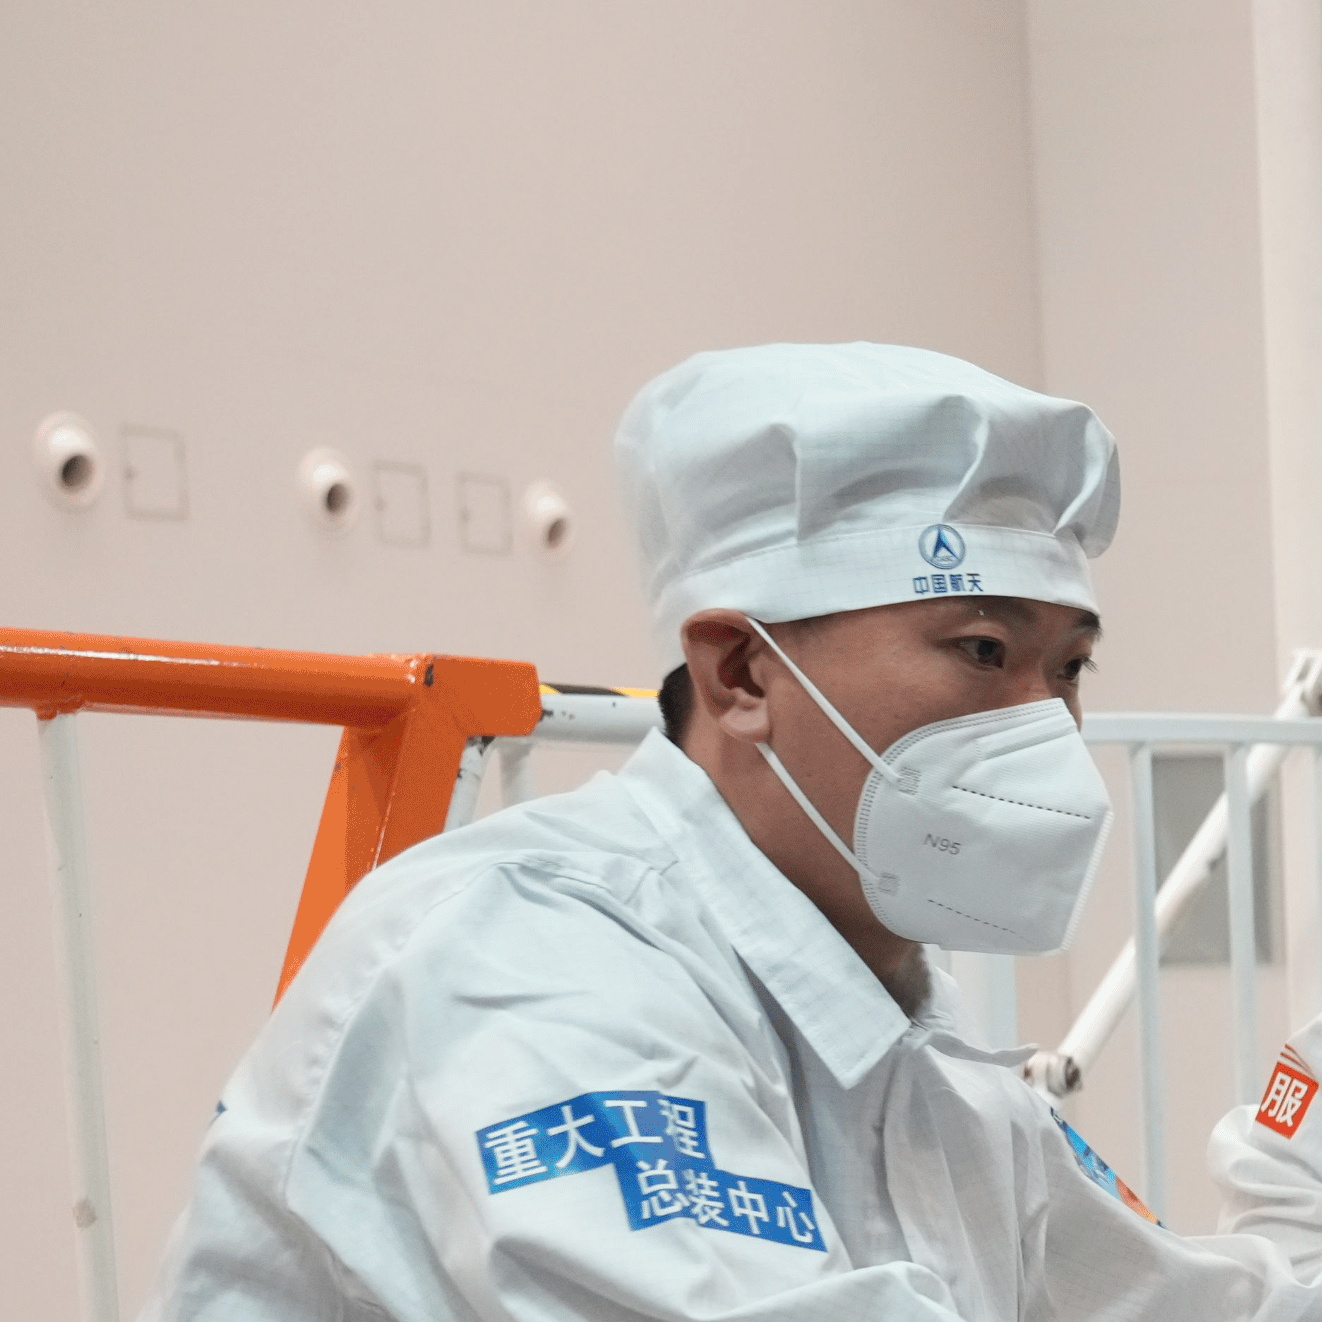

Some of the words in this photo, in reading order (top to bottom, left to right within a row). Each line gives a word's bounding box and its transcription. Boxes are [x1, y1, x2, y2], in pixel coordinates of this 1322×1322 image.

[913, 573, 984, 595] 中国航天
[923, 833, 962, 855] N95
[1261, 1072, 1308, 1128] 服
[484, 1100, 706, 1185] 重大工程
[637, 1159, 816, 1244] 总装中心
